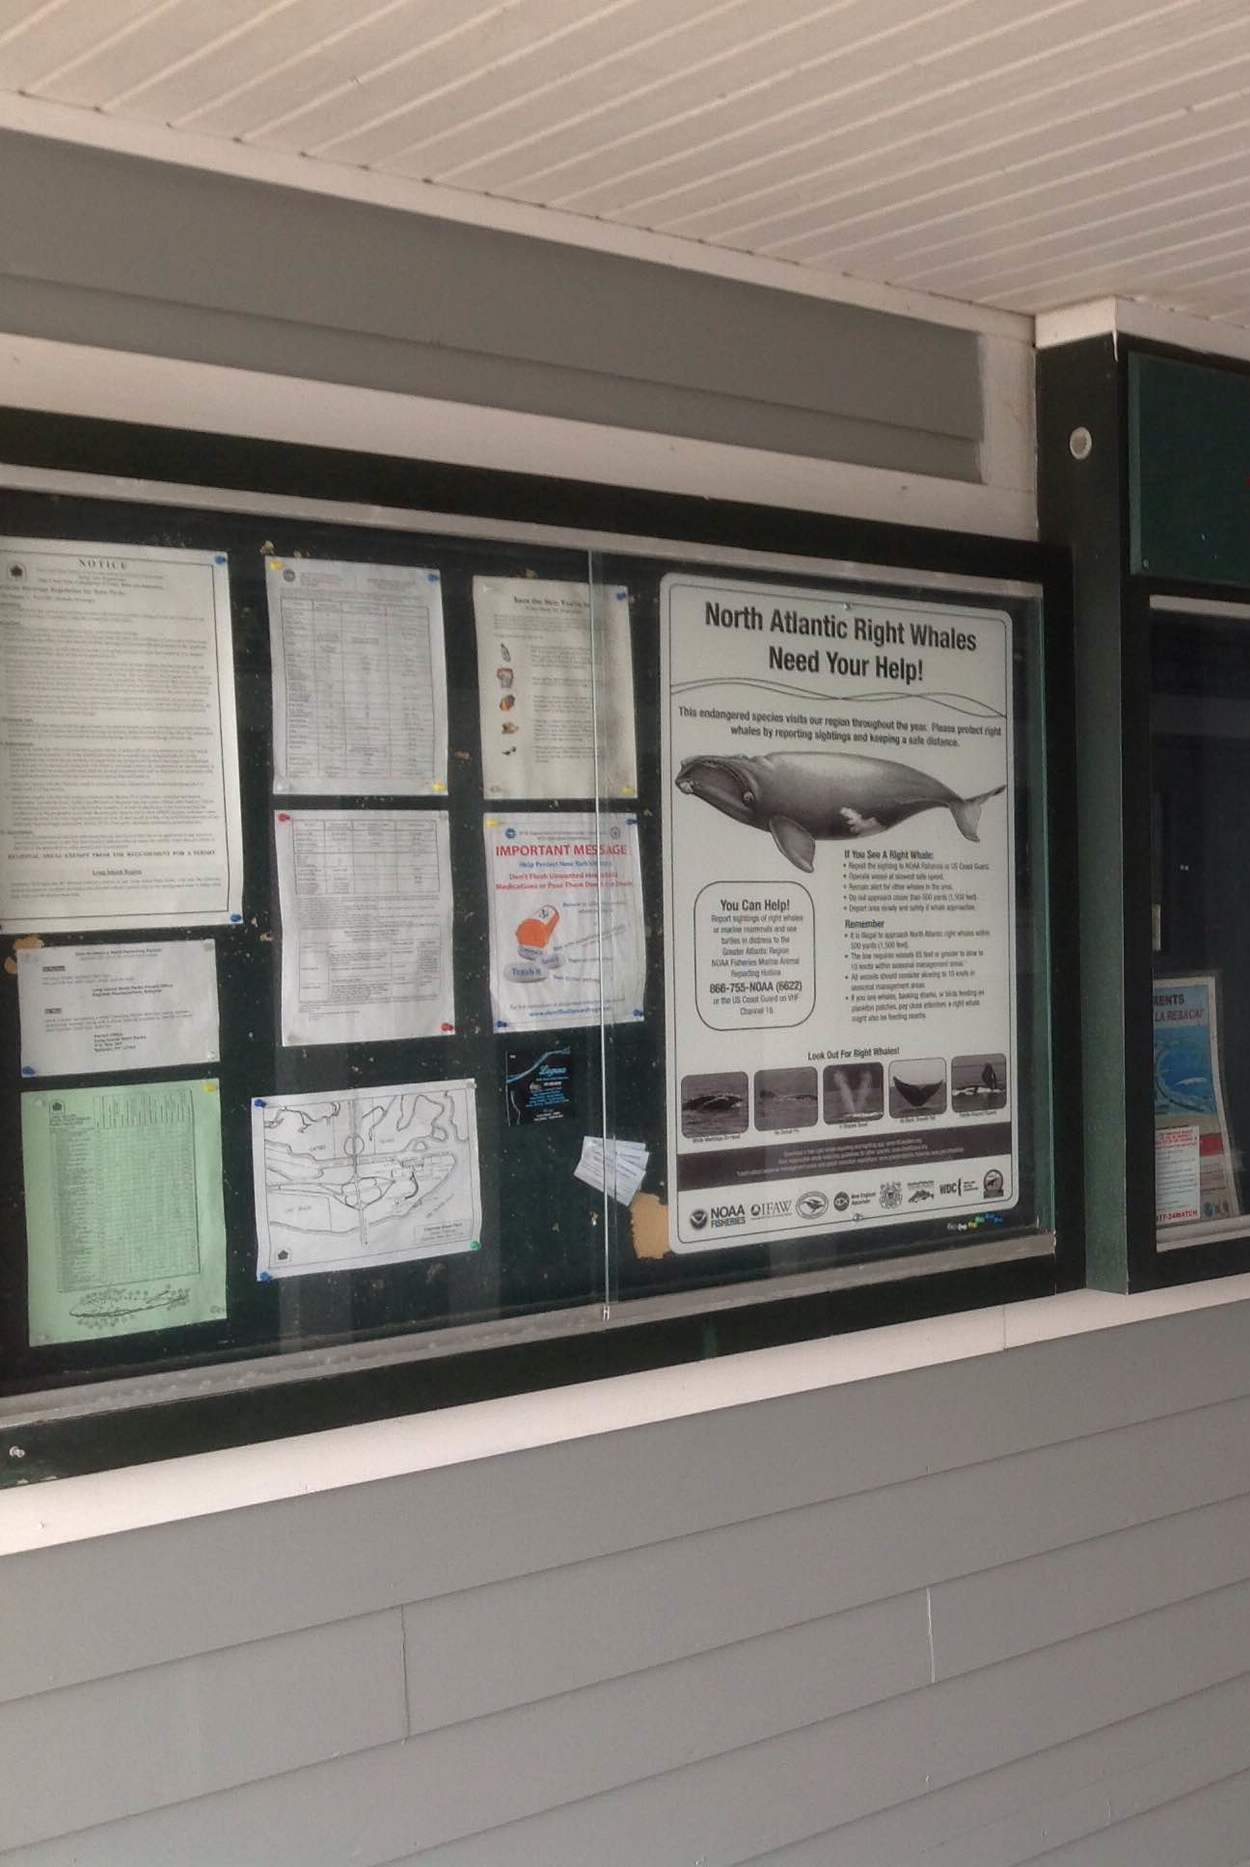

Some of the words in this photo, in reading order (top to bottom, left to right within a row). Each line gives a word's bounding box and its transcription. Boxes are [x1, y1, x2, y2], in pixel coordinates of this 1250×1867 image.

[705, 601, 763, 630] North
[770, 609, 848, 639] Atlantic
[854, 618, 904, 647] Right
[910, 624, 977, 651] Whales
[769, 647, 820, 673] Need
[826, 652, 869, 676] Your
[875, 656, 923, 685] Help!
[679, 706, 697, 717] This
[699, 708, 750, 721] endangered
[752, 713, 783, 723] species
[785, 714, 807, 723] visits
[852, 718, 894, 730] throughout
[730, 726, 761, 736] whales
[763, 727, 773, 738] by
[775, 729, 812, 740] reporting
[815, 731, 851, 742] sightings
[853, 733, 867, 742] and
[496, 845, 571, 856] IMPORTANT
[720, 900, 738, 911] You
[742, 900, 761, 911] Can
[765, 900, 790, 912] Help!
[807, 1052, 825, 1060] Look
[826, 1050, 839, 1059] Out
[710, 1204, 745, 1218] NOAA
